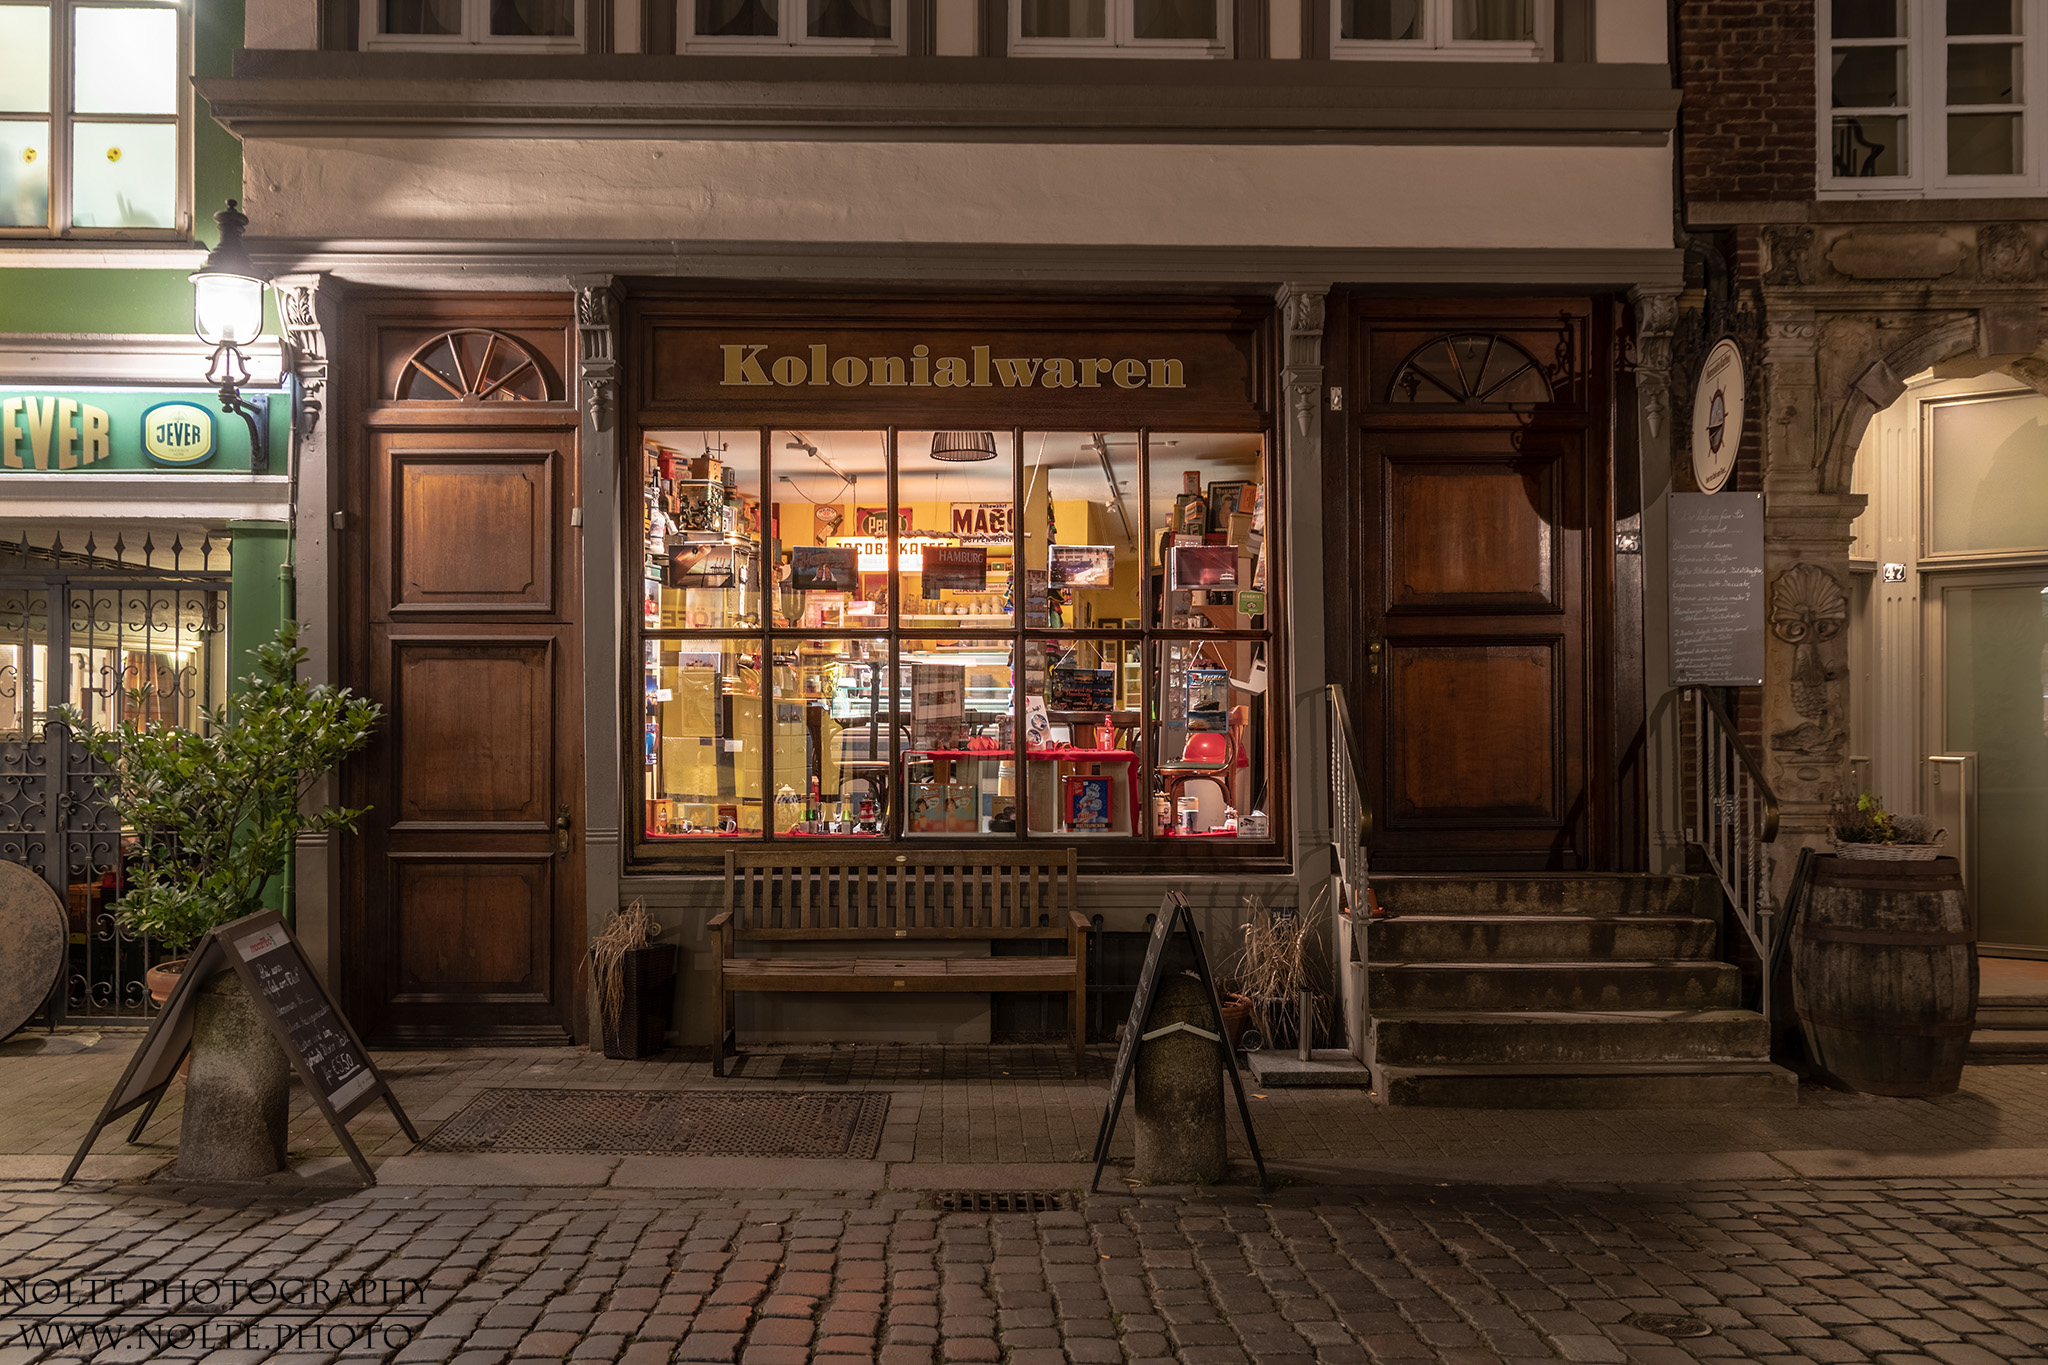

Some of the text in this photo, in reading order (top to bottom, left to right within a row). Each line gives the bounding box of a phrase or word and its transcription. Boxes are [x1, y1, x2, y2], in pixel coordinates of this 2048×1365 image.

[719, 343, 1188, 389] Kolonialwaren
[156, 422, 201, 447] JEVER
[953, 508, 1014, 534] MAG
[1618, 535, 1639, 552] 45
[938, 549, 984, 564] HAMBURG
[1885, 565, 1904, 580] 47
